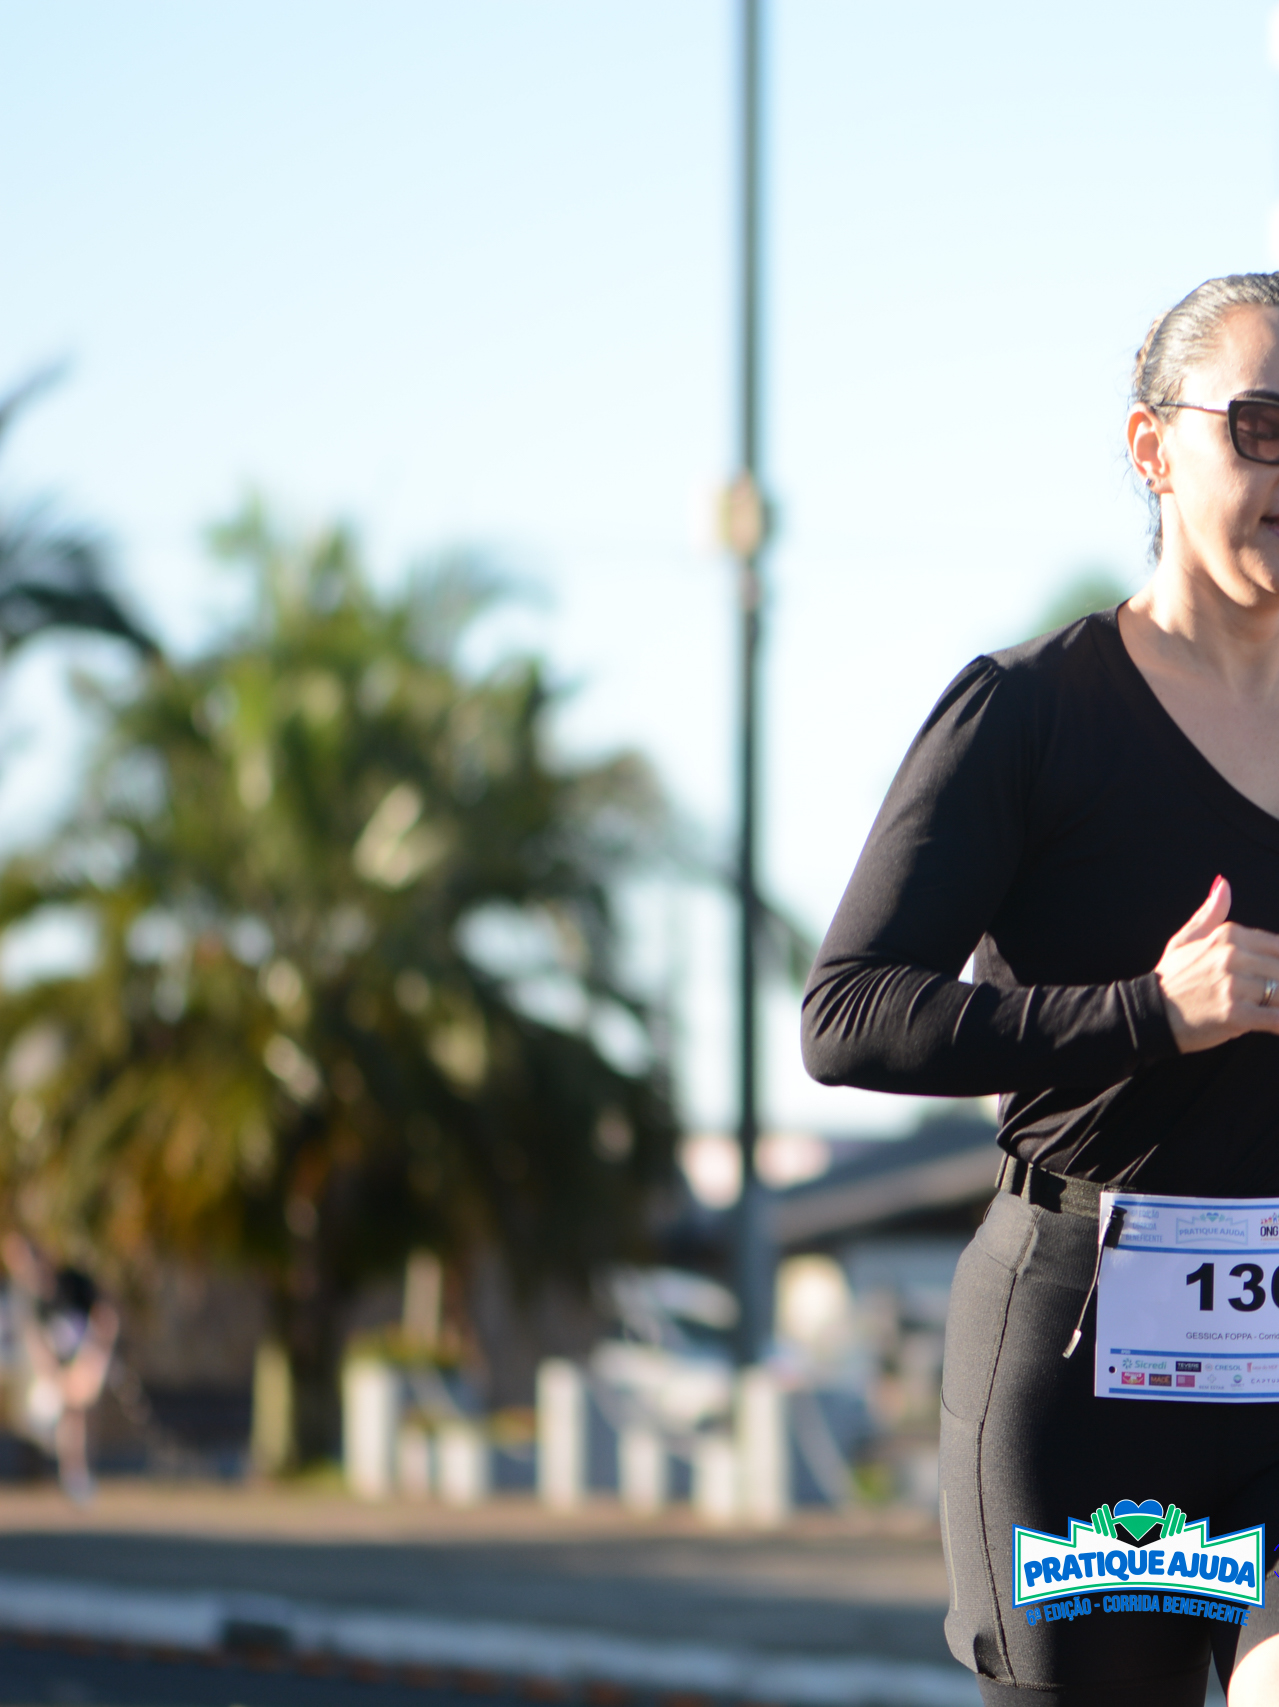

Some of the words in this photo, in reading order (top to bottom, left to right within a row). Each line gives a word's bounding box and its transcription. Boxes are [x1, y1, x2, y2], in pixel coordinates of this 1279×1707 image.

[1179, 1227, 1219, 1237] PRATIQUE
[1219, 1228, 1245, 1237] AJUDA
[1260, 1226, 1279, 1237] ONG
[1125, 1233, 1164, 1243] BENEFICENTE
[1186, 1332, 1223, 1340] GESSICA
[1135, 1360, 1167, 1370] Sicredi
